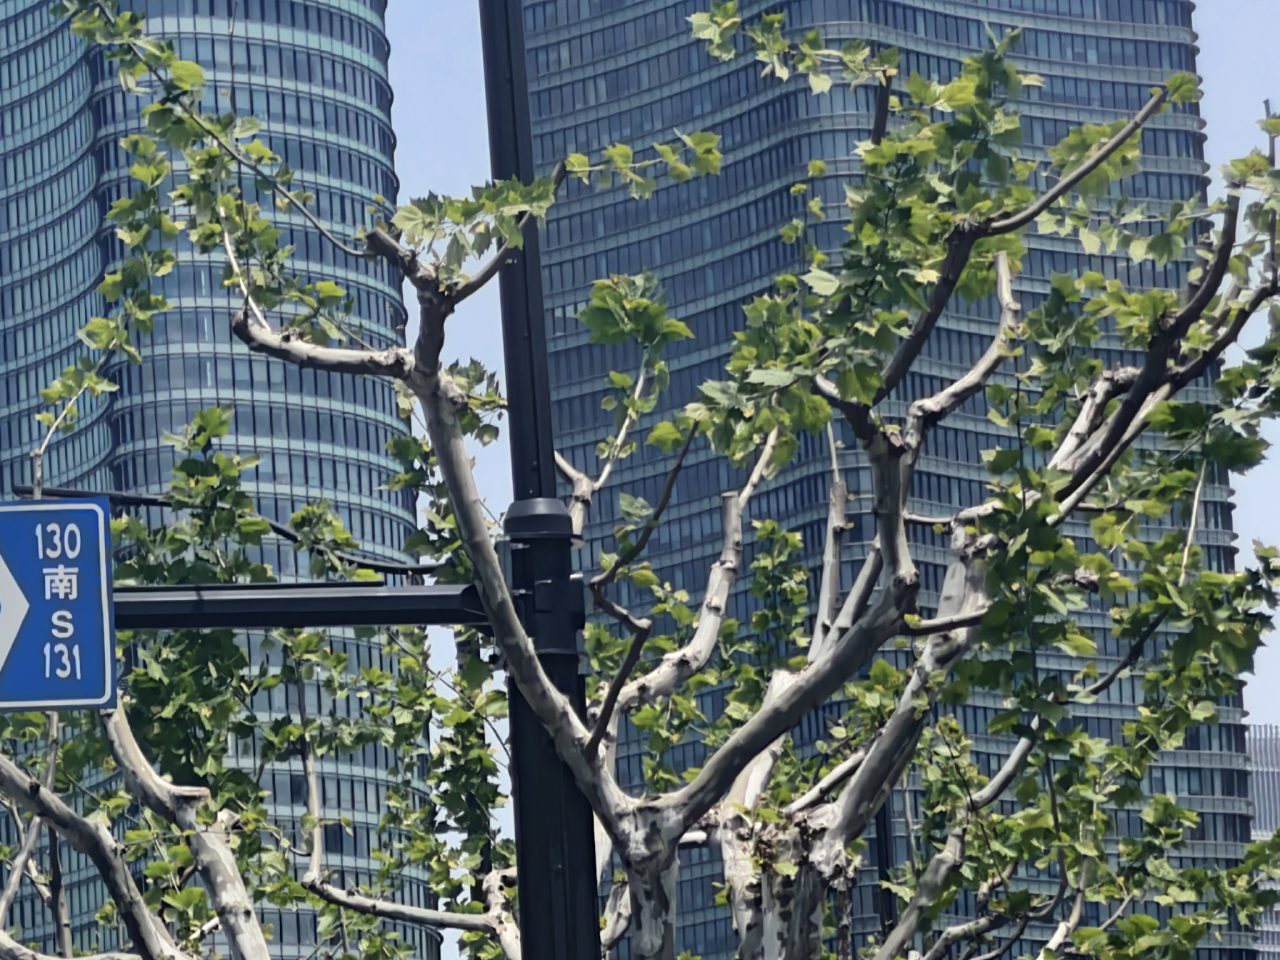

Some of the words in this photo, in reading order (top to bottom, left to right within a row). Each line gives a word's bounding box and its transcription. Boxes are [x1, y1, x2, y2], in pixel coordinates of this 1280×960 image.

[35, 523, 81, 560] 130
[43, 564, 79, 600] 南
[51, 610, 75, 639] S
[43, 644, 82, 680] 131
